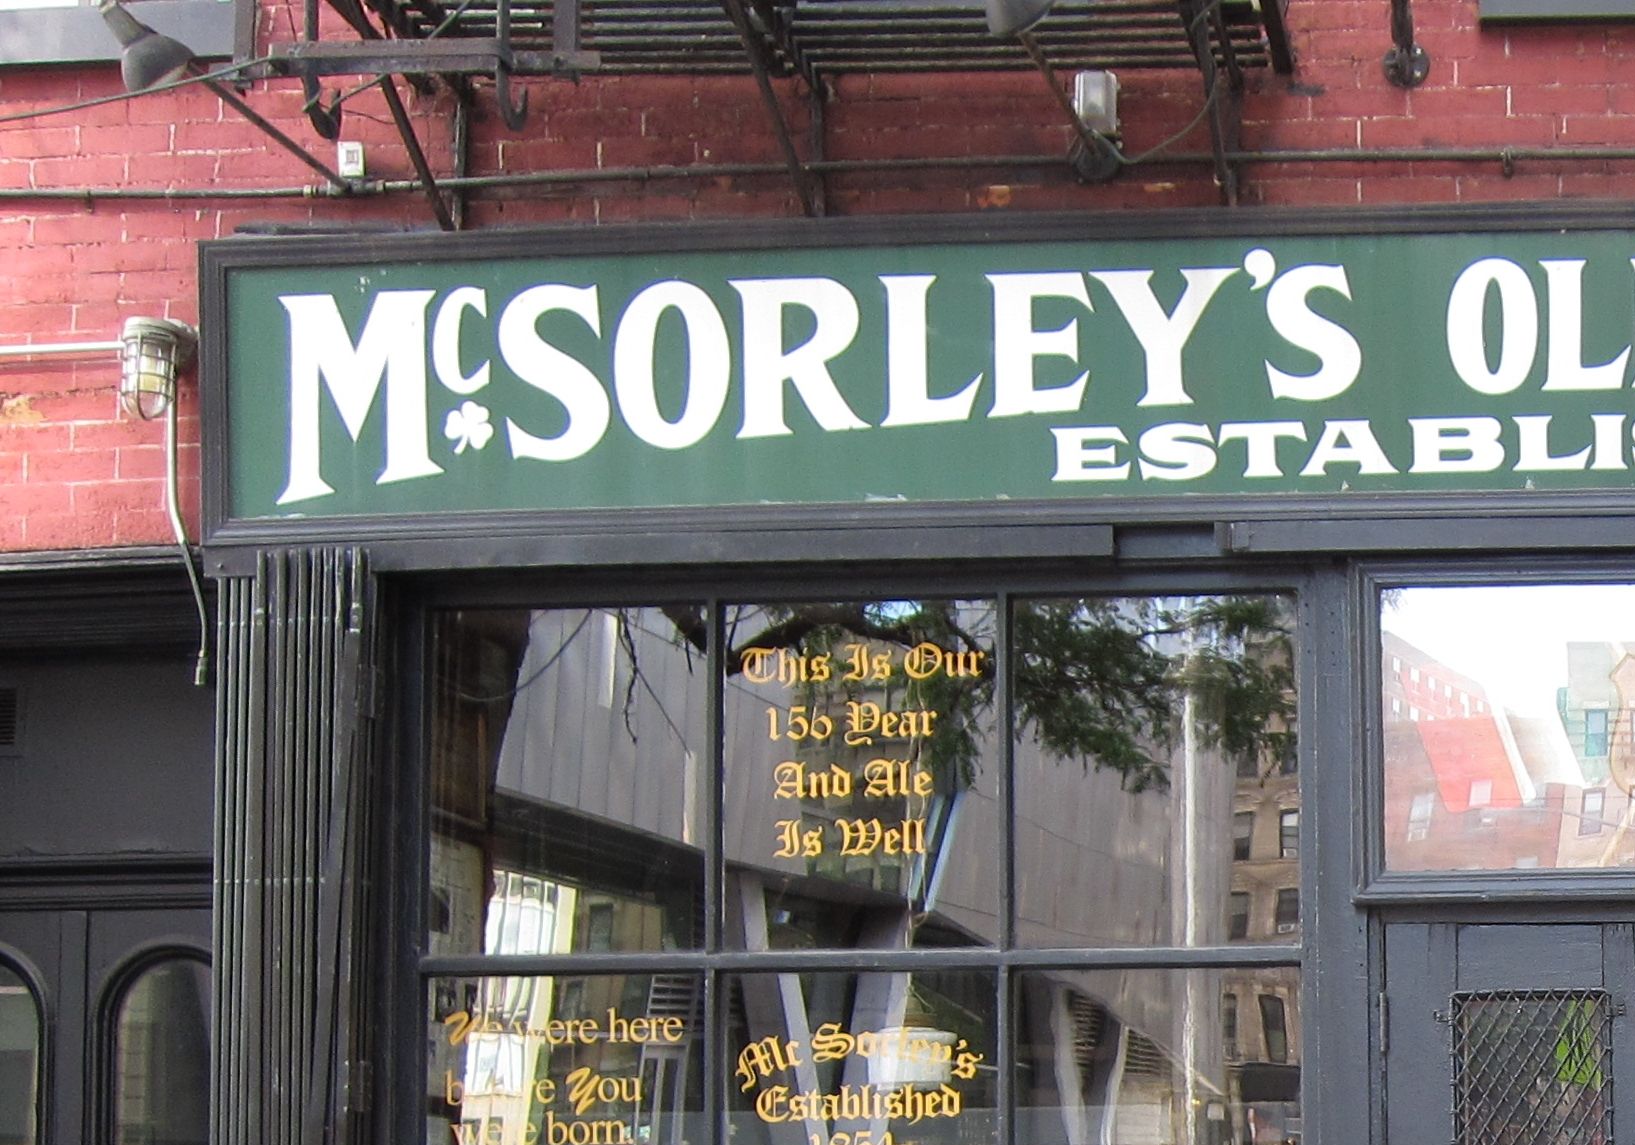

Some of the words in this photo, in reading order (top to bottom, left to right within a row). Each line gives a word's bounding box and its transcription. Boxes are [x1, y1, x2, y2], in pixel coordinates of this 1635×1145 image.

[741, 646, 831, 689] This
[842, 643, 892, 682] Is
[904, 642, 985, 680] Our
[766, 706, 833, 741] 156
[844, 701, 938, 746] Year
[774, 761, 852, 800] And
[864, 758, 933, 800] Ale
[773, 819, 823, 858] Is
[835, 818, 927, 857] Well
[607, 1007, 683, 1044] here
[735, 1034, 805, 1093] Mc
[811, 1022, 984, 1080] Sorley's
[565, 1066, 642, 1116] You
[755, 1083, 962, 1126] Established
